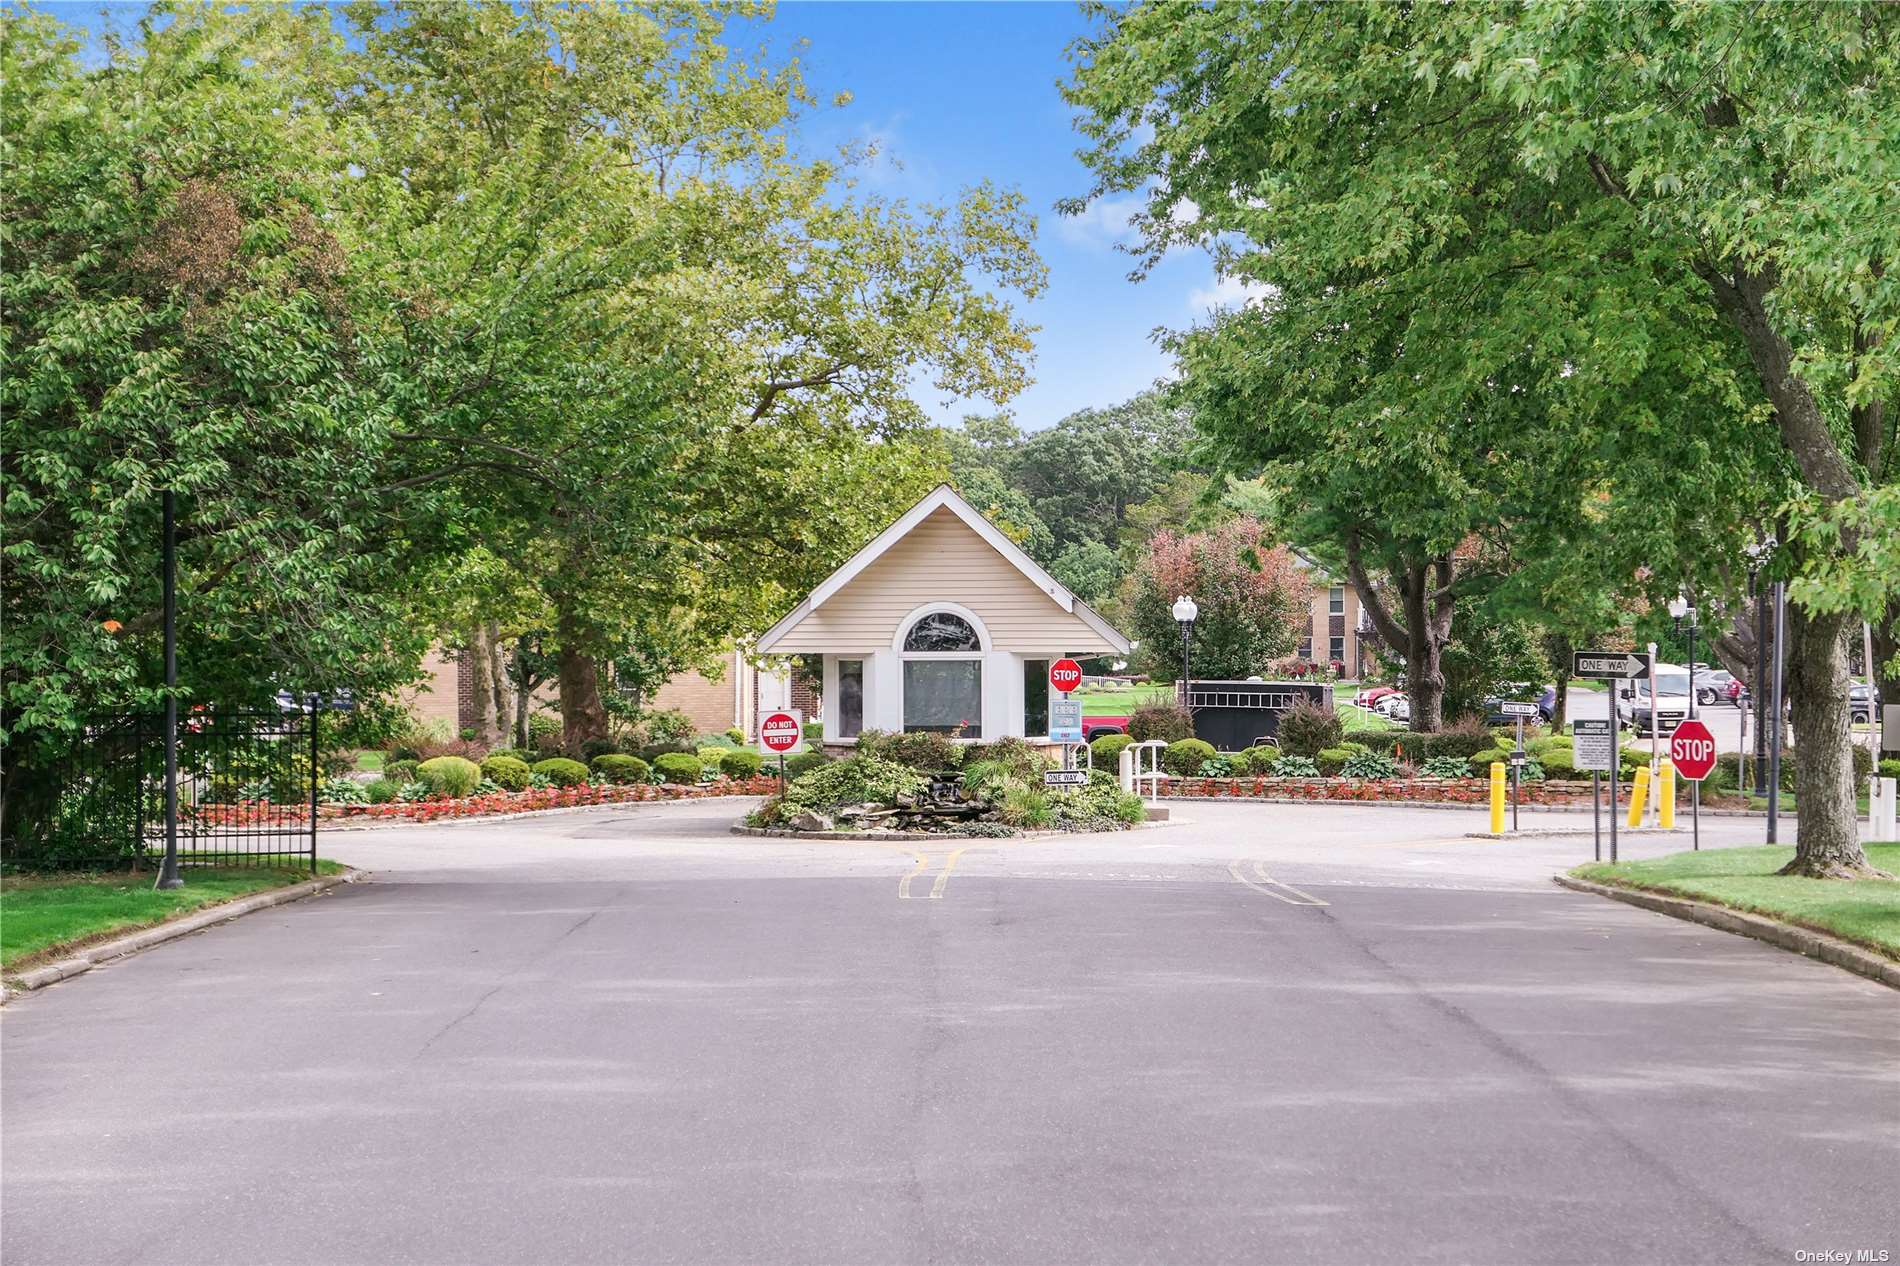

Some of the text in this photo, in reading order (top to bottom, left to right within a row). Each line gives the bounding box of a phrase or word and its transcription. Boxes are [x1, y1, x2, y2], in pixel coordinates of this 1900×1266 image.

[1581, 661, 1629, 670] ONE WAY
[1053, 670, 1079, 681] STOP
[1673, 739, 1714, 761] STOP
[1048, 774, 1078, 782] ONE WAY
